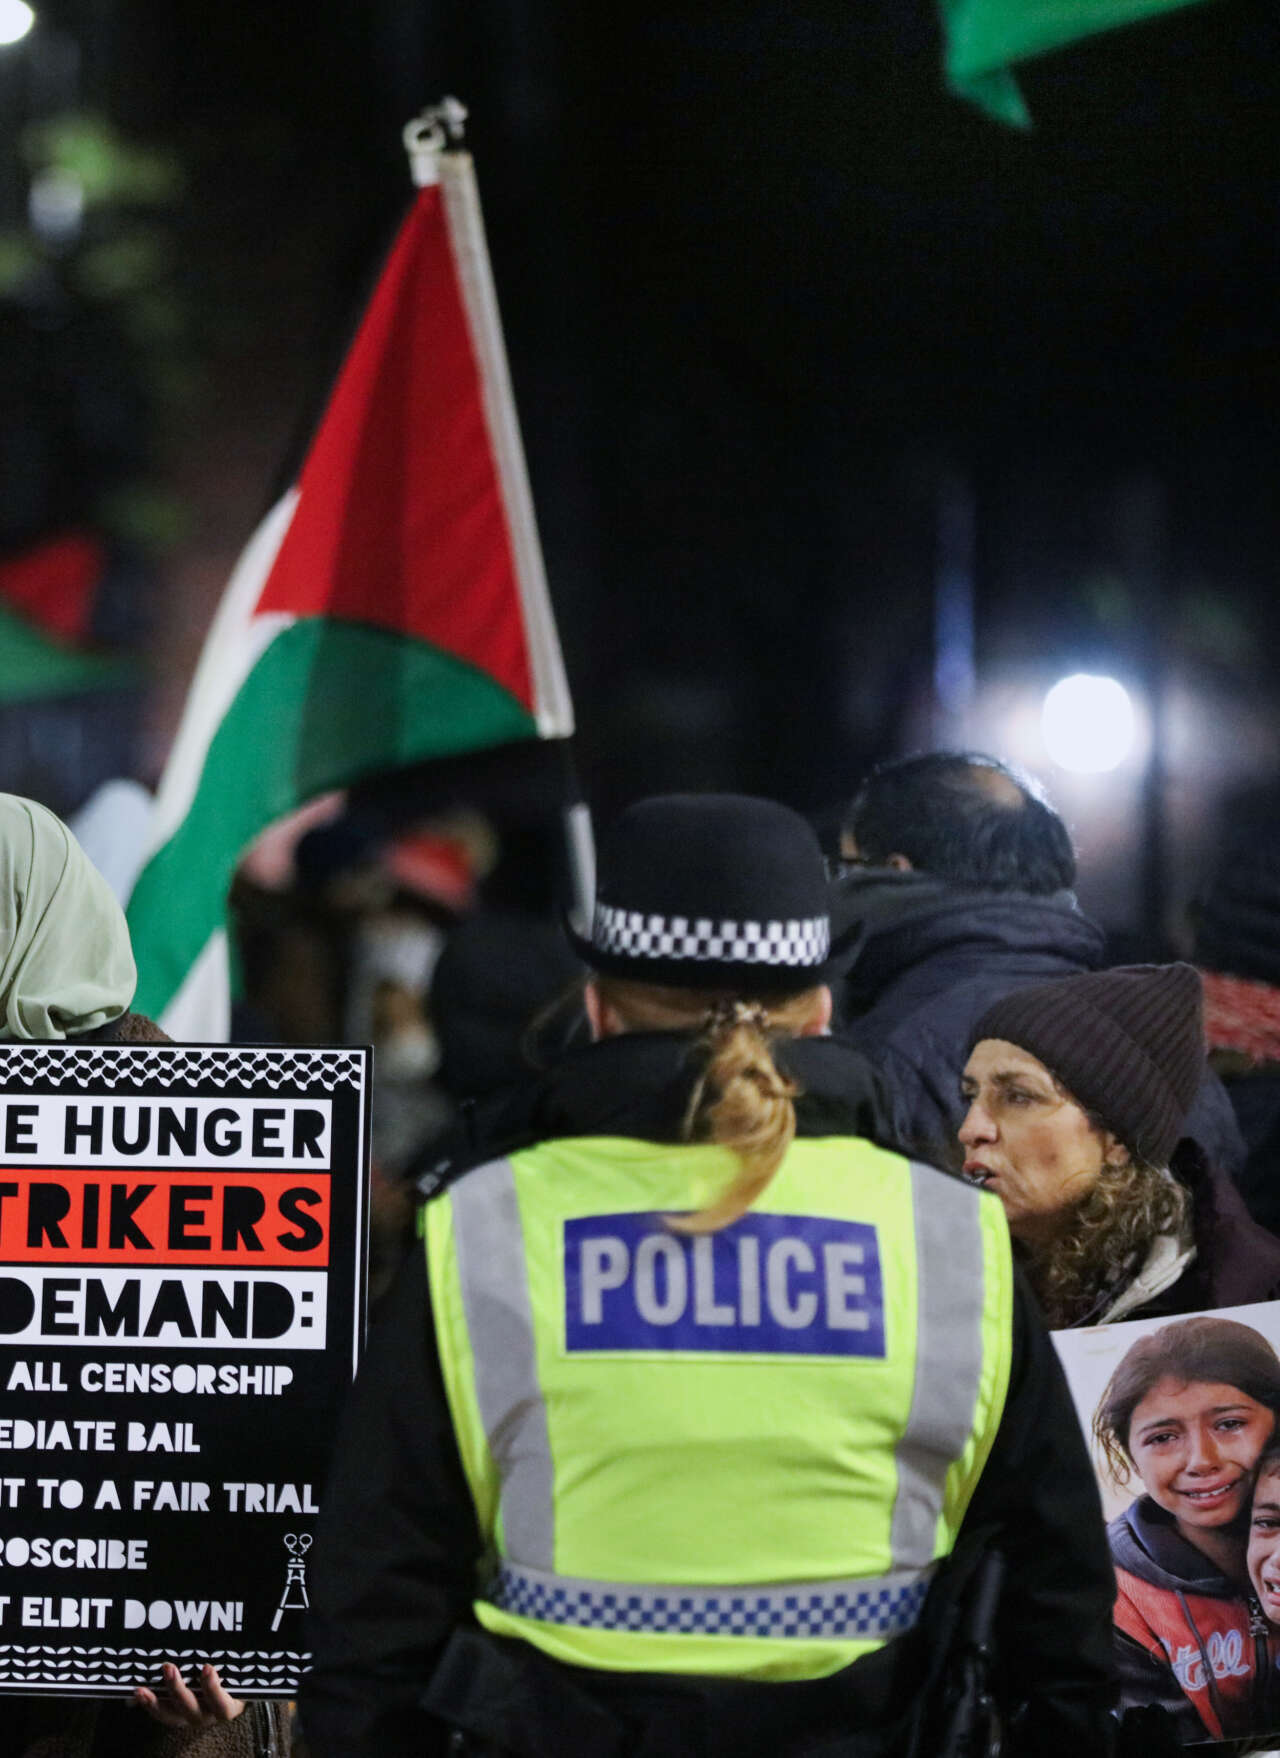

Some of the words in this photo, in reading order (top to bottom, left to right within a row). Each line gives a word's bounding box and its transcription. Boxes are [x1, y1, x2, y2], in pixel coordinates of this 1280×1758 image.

[63, 1104, 326, 1160] HUNGER
[580, 1234, 871, 1332] POLICE
[6, 1361, 68, 1393] ALL
[80, 1362, 294, 1396] CENSORSHIP
[126, 1421, 202, 1454] BAIL
[36, 1478, 84, 1510] TO
[93, 1480, 122, 1511] A
[133, 1480, 211, 1513] FAIR
[222, 1482, 320, 1515] TRIAL
[21, 1596, 113, 1630] ELBIT
[124, 1599, 244, 1633] DOWN!
